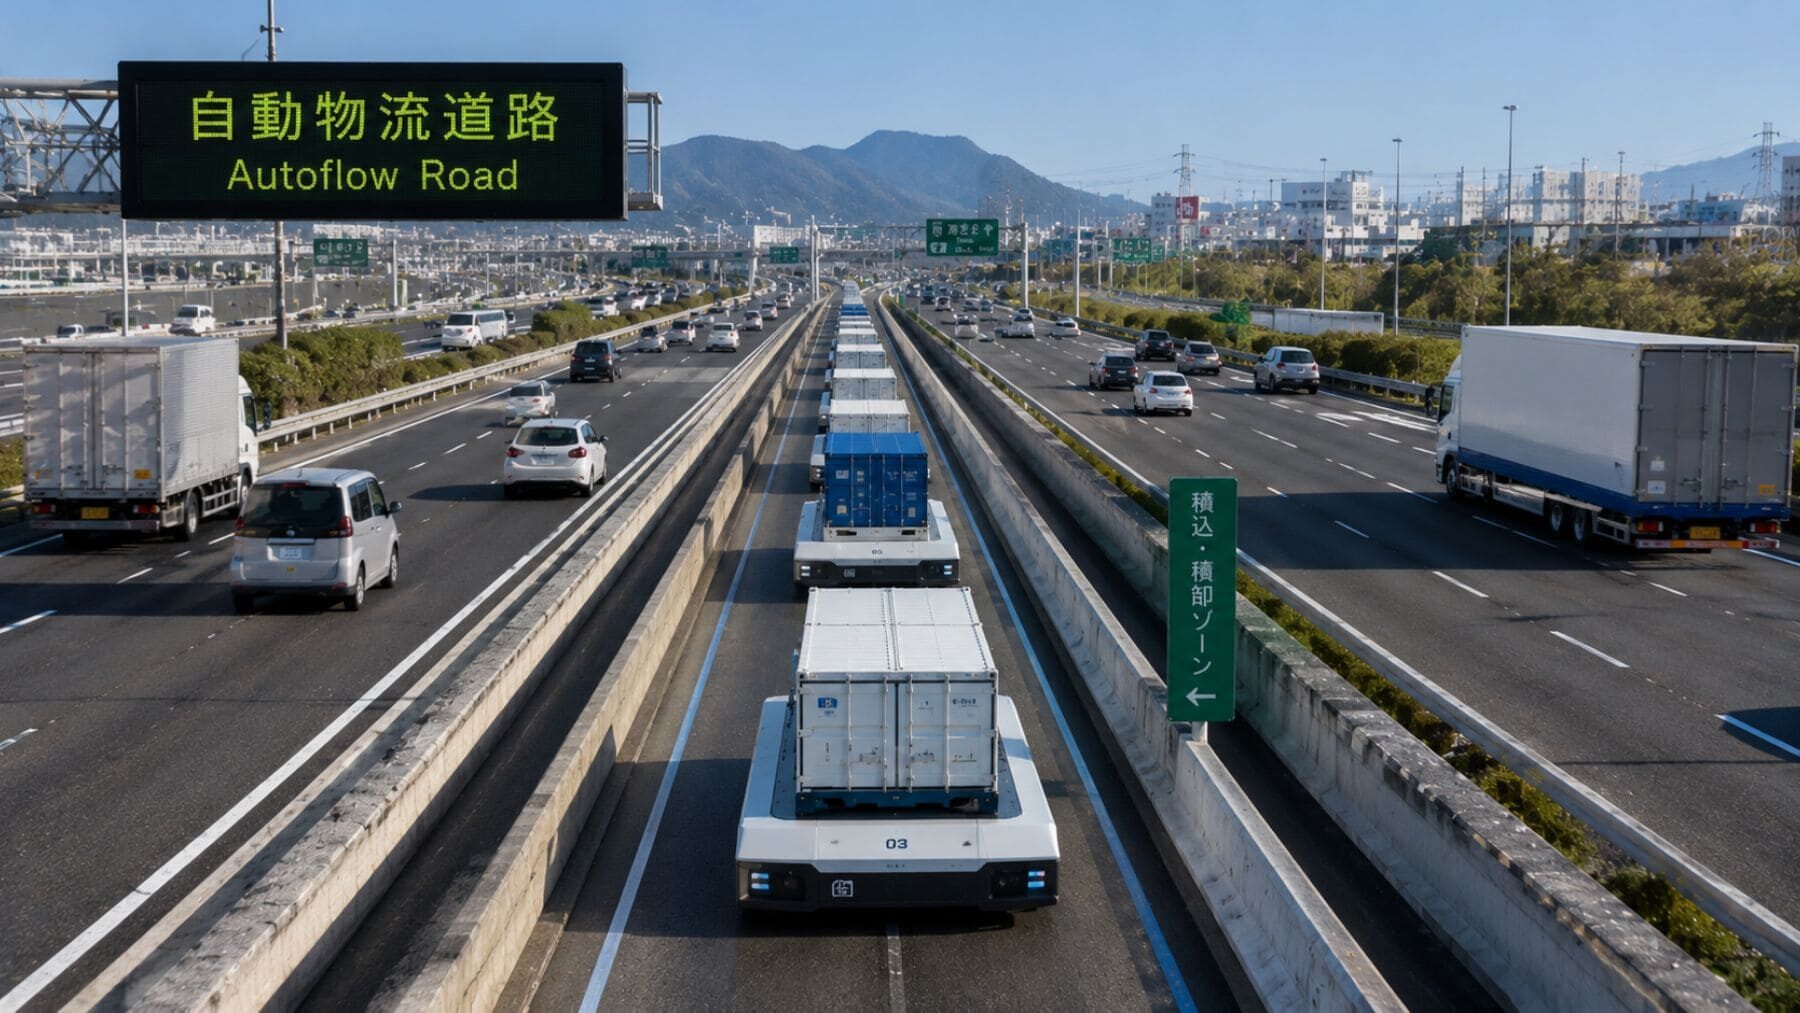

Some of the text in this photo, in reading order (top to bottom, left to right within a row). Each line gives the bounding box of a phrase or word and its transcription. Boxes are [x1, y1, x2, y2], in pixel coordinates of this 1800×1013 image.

[192, 90, 559, 141] 自動物流道路
[226, 158, 518, 190] Autoflow Road
[886, 838, 908, 849] 03
